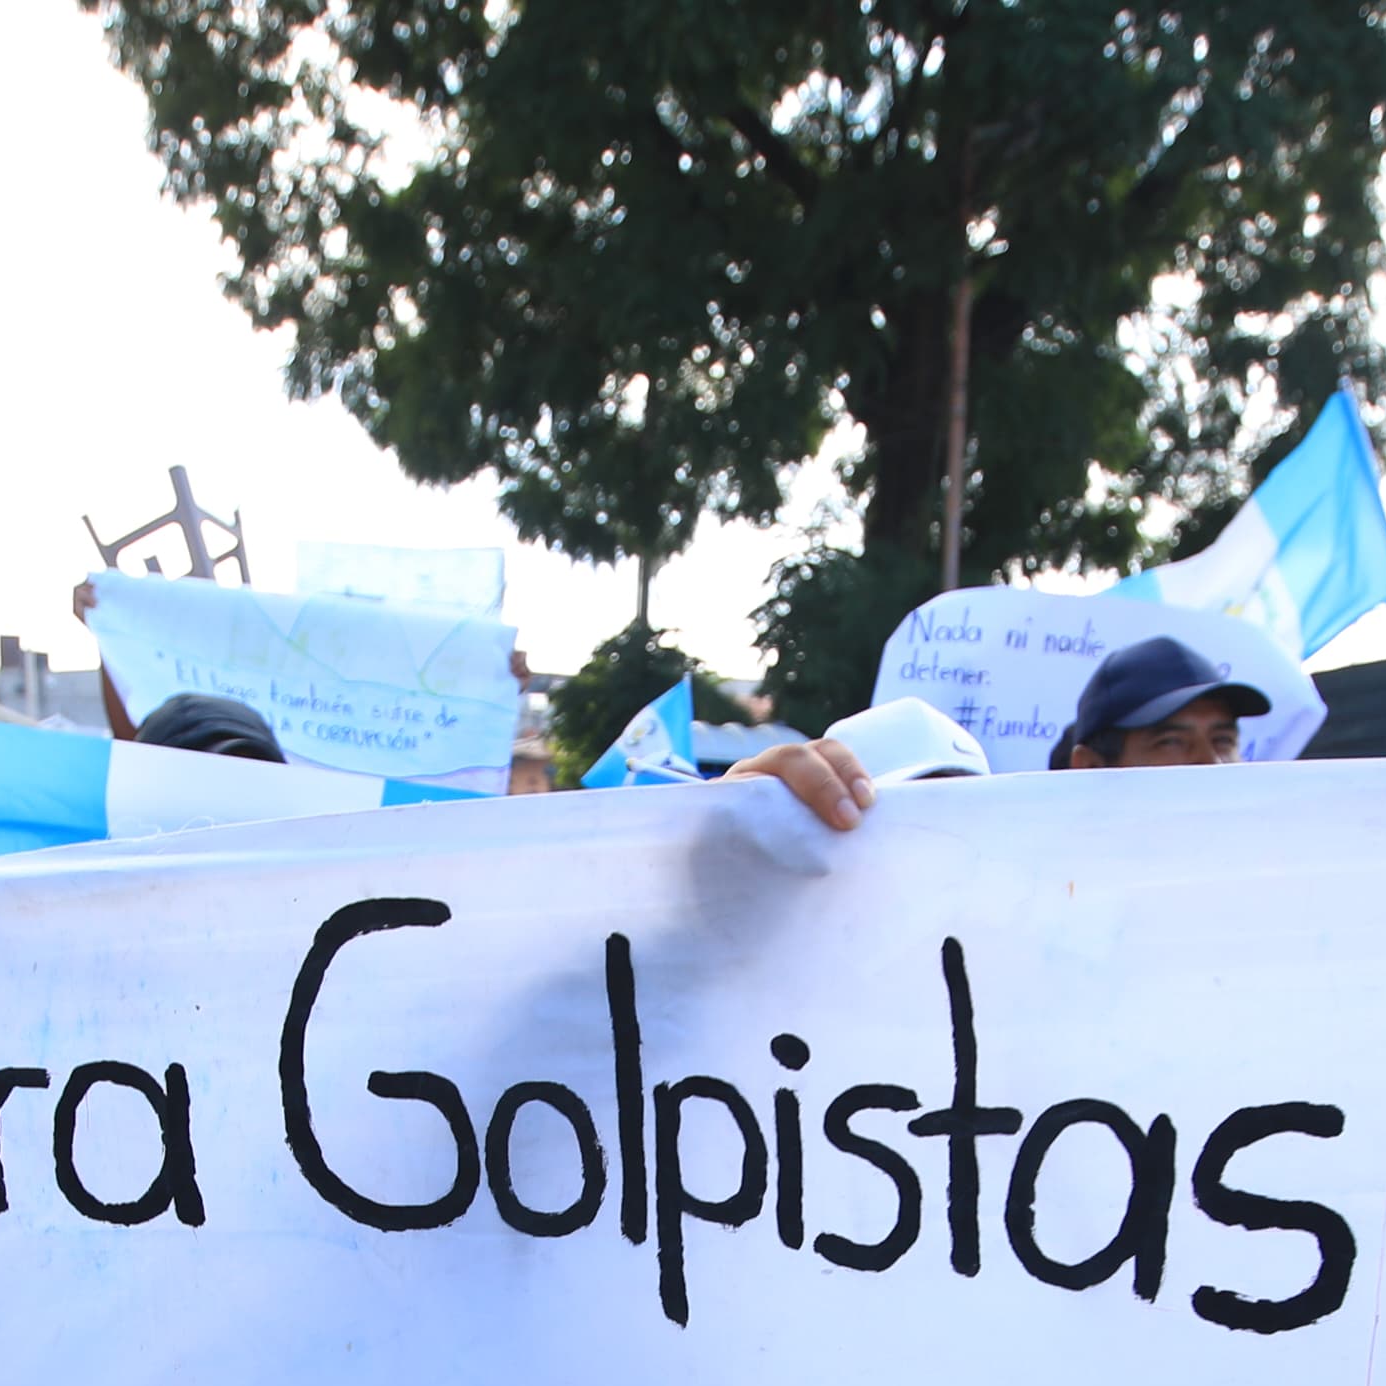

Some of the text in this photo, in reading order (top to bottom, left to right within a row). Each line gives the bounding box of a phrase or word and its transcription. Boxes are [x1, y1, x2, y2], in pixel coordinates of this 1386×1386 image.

[908, 606, 1106, 657] Nada ni nadie
[435, 703, 460, 729] de
[279, 897, 1356, 1334] Golpistas
